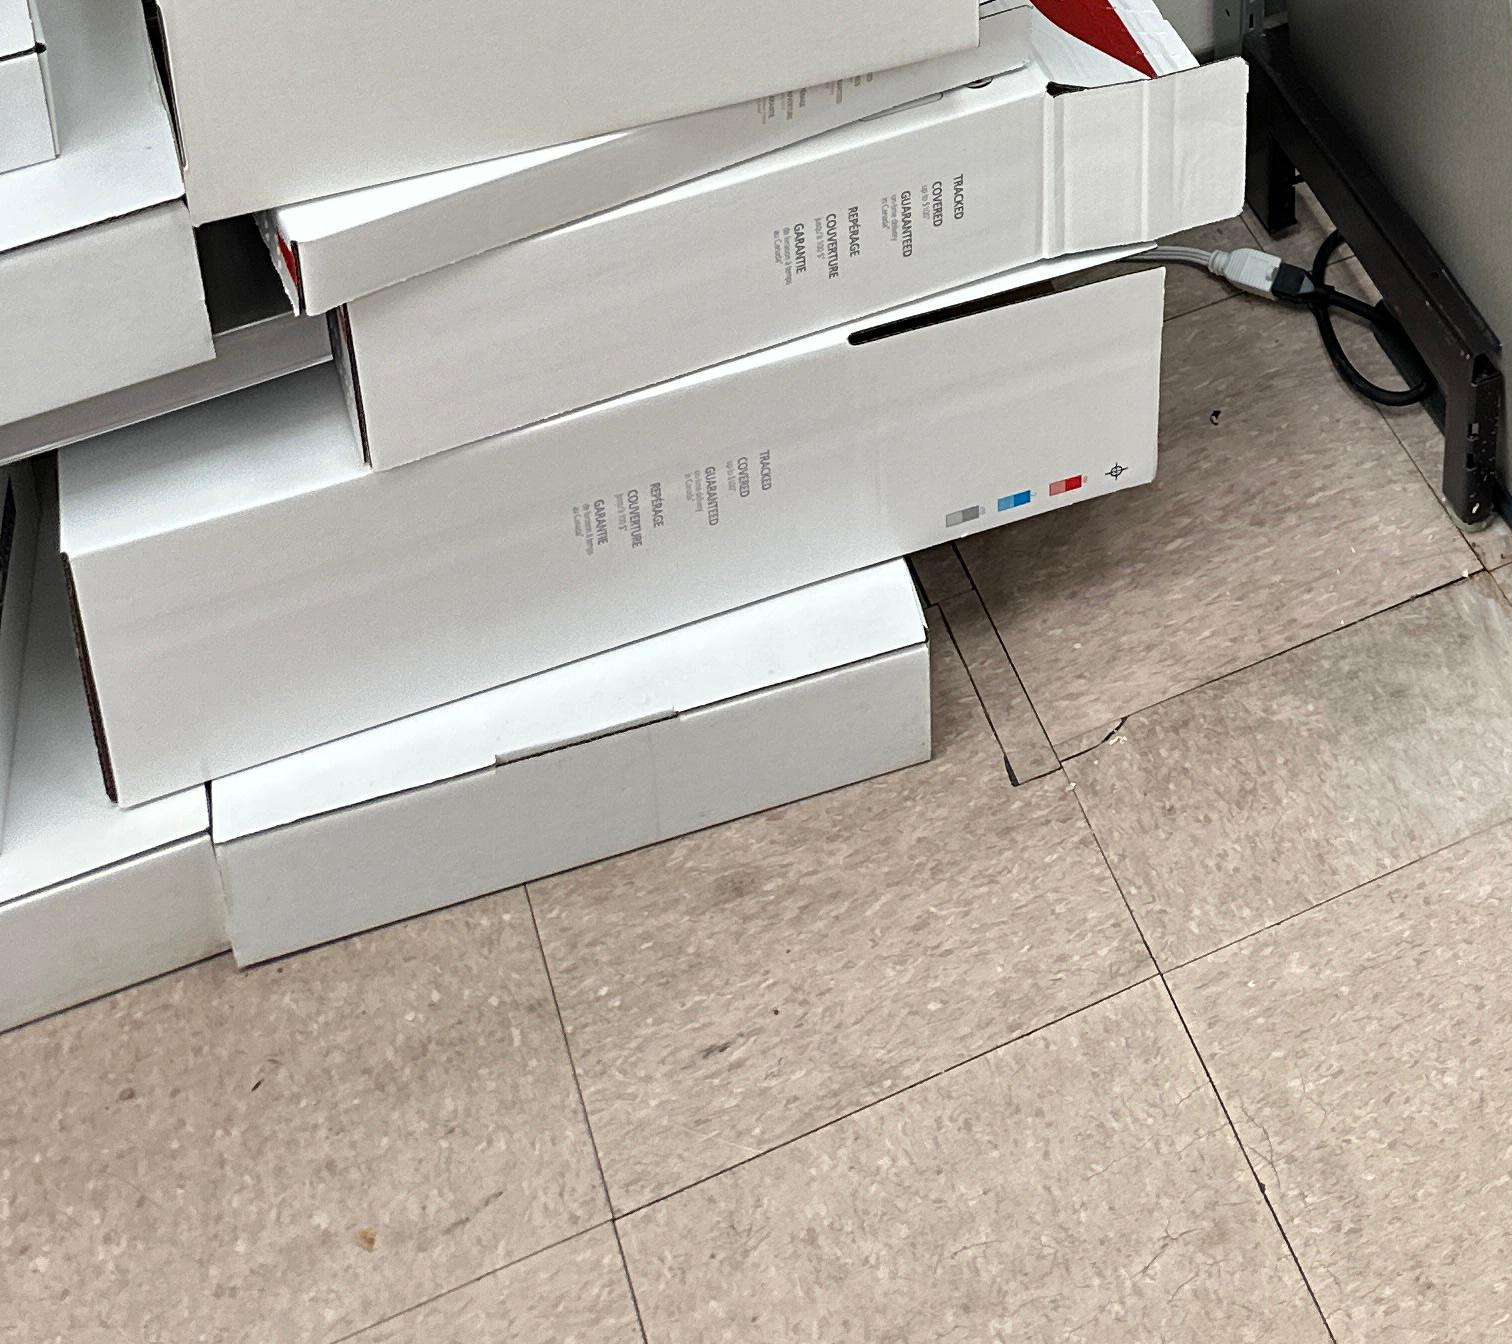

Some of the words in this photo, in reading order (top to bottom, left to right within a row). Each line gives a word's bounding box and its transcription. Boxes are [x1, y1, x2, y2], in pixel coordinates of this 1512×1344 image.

[931, 181, 943, 227] COVERED
[953, 174, 964, 220] TRACKED
[794, 223, 807, 274] GARANTIE
[826, 214, 839, 279] COUVERTURE
[848, 206, 861, 258] REPÉRAGE
[900, 190, 913, 258] GUARANTEED
